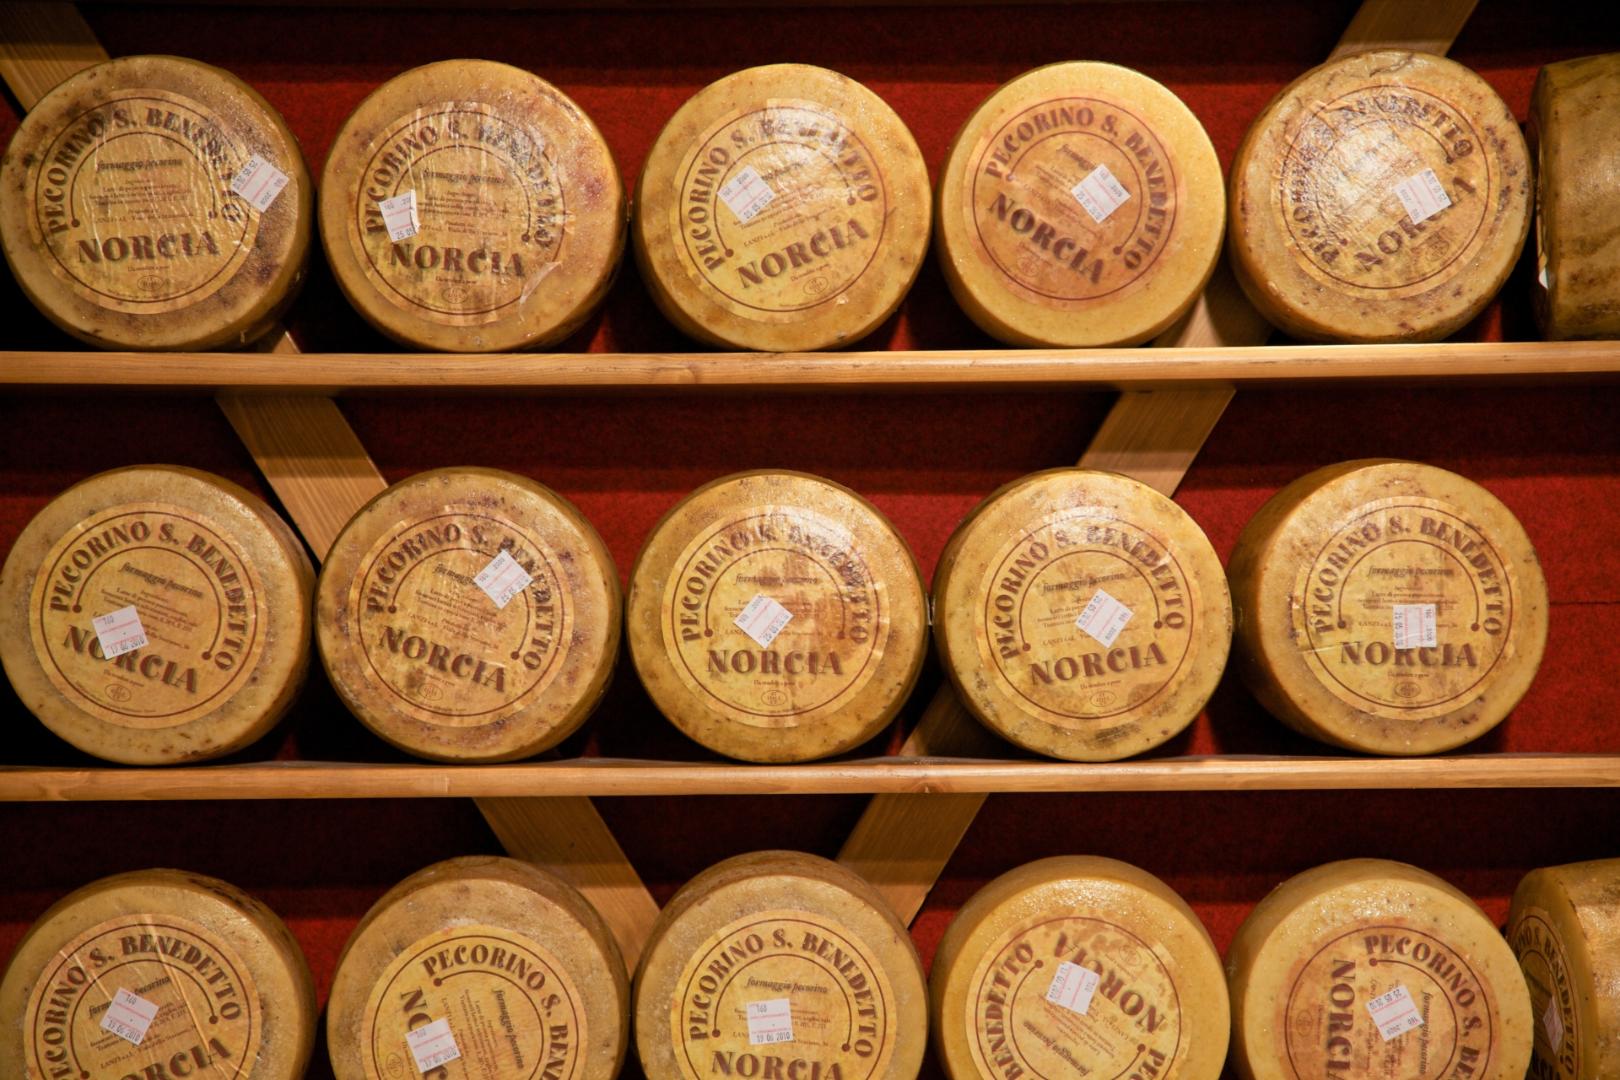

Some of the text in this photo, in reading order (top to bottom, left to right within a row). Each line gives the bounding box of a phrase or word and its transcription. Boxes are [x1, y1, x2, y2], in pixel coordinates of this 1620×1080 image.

[47, 115, 105, 235] PECORINO
[113, 108, 137, 128] S.
[365, 125, 438, 235] PECORINO
[688, 147, 730, 271] PECORINO
[730, 129, 755, 149] S.
[985, 107, 1095, 178] PECORINO
[1100, 115, 1119, 136] S.
[1124, 131, 1168, 270] BENEDETTO
[79, 231, 219, 263] NORCIA
[389, 242, 525, 277] NORCIA
[735, 218, 869, 288] NORCIA
[987, 192, 1104, 284] NORCIA
[50, 521, 151, 613] PECORINO
[158, 522, 180, 545] S.
[186, 533, 248, 671] BENEDETTO
[366, 523, 461, 614] PECORINO
[470, 524, 489, 546] S.
[499, 535, 554, 670] BENEDETTO
[679, 531, 750, 643] PECORINO
[992, 541, 1050, 660] PECORINO
[1086, 526, 1186, 630] BENEDETTO
[1309, 522, 1382, 635] PECORINO
[1389, 516, 1411, 534] S.
[1420, 516, 1504, 636] BENEDETTO
[62, 624, 198, 694] NORCIA
[378, 625, 505, 693] NORCIA
[707, 650, 843, 675] NORCIA
[1028, 642, 1167, 686] NORCIA
[1340, 641, 1477, 667] NORCIA
[43, 965, 86, 1080] ECORINO
[89, 948, 115, 968] S.
[121, 934, 242, 1021] BENEDETTO
[421, 944, 546, 991] PECORINO
[540, 994, 561, 1018] S.
[690, 934, 764, 1041] PECORINO
[772, 929, 792, 949] S.
[802, 932, 878, 1057] BENEDETTO
[745, 976, 829, 995] formaggio pecorino
[986, 942, 1034, 1080] BENEDETTO
[1364, 935, 1476, 1008] PECORINO
[1462, 1015, 1483, 1037] S.
[711, 1051, 842, 1080] NORCIA
[776, 1030, 792, 1042] 2010
